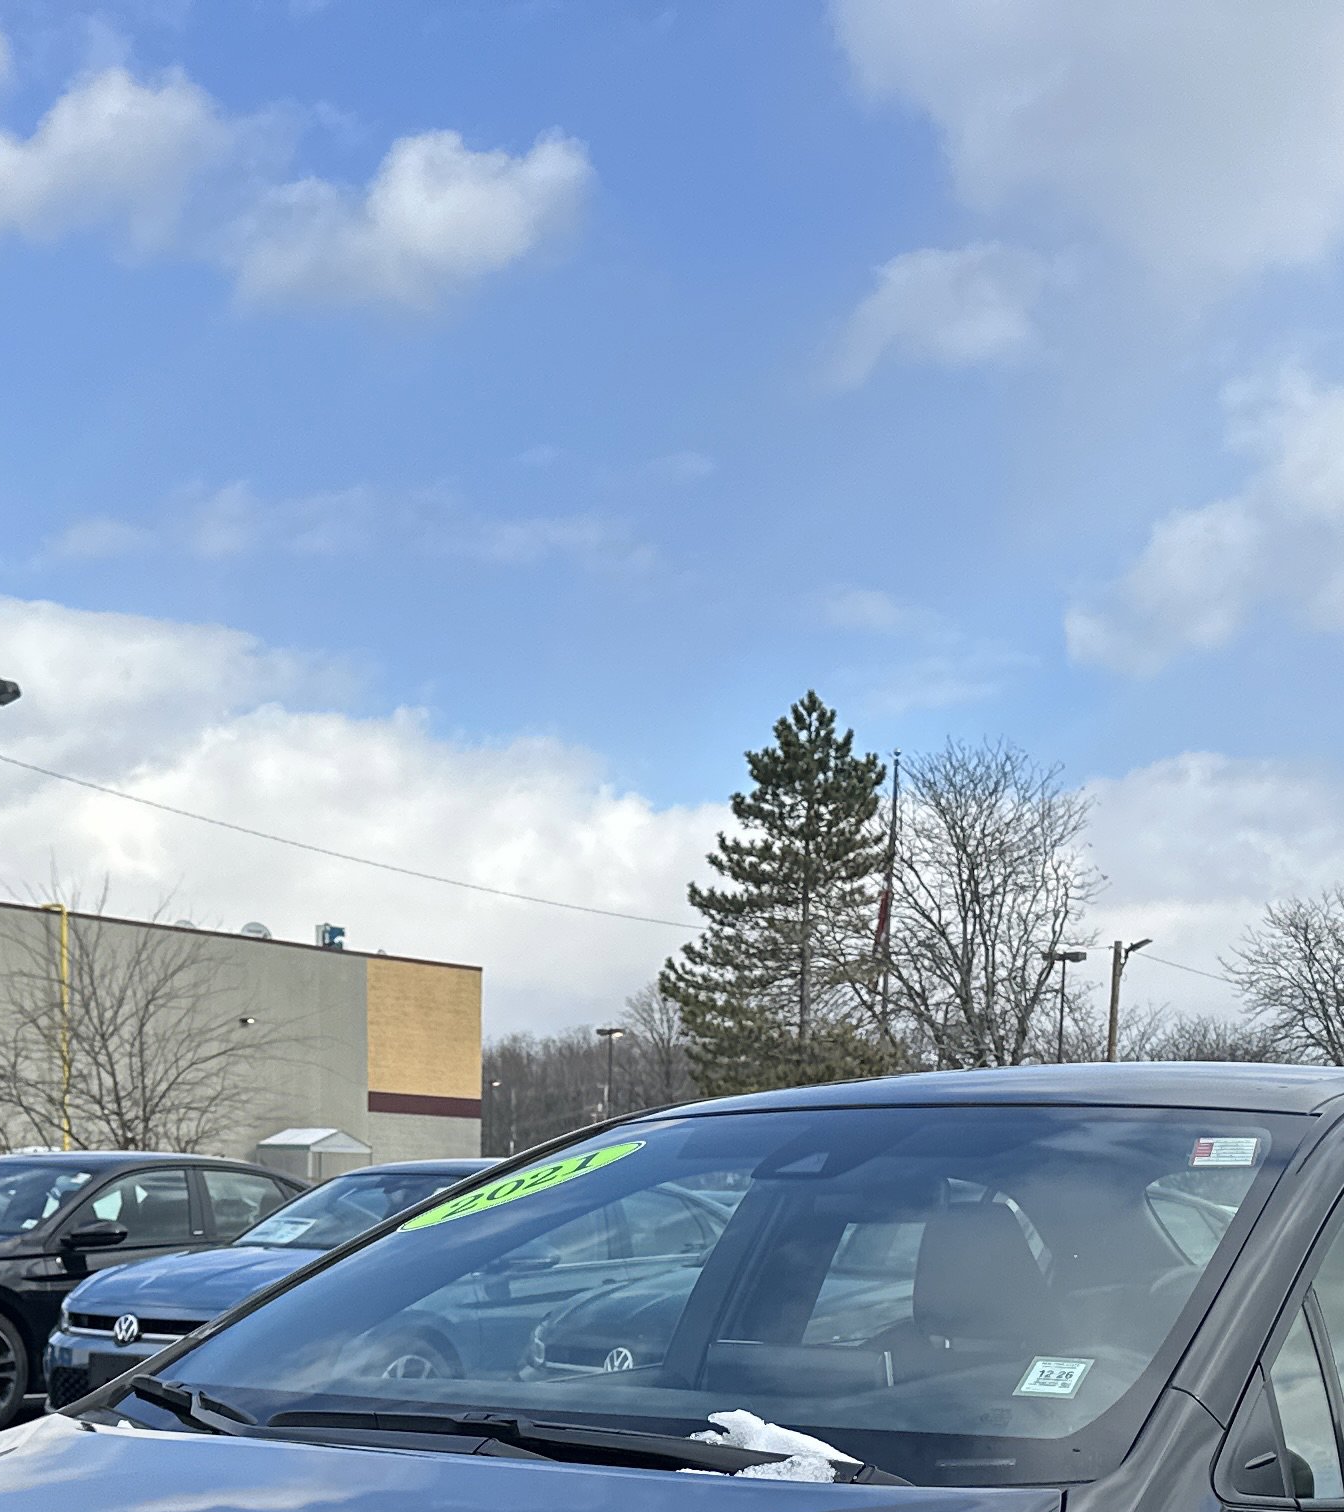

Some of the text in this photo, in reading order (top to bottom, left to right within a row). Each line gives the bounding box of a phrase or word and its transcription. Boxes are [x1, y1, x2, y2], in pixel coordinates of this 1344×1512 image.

[440, 1151, 600, 1221] 2021
[1038, 1369, 1075, 1379] 12 26
